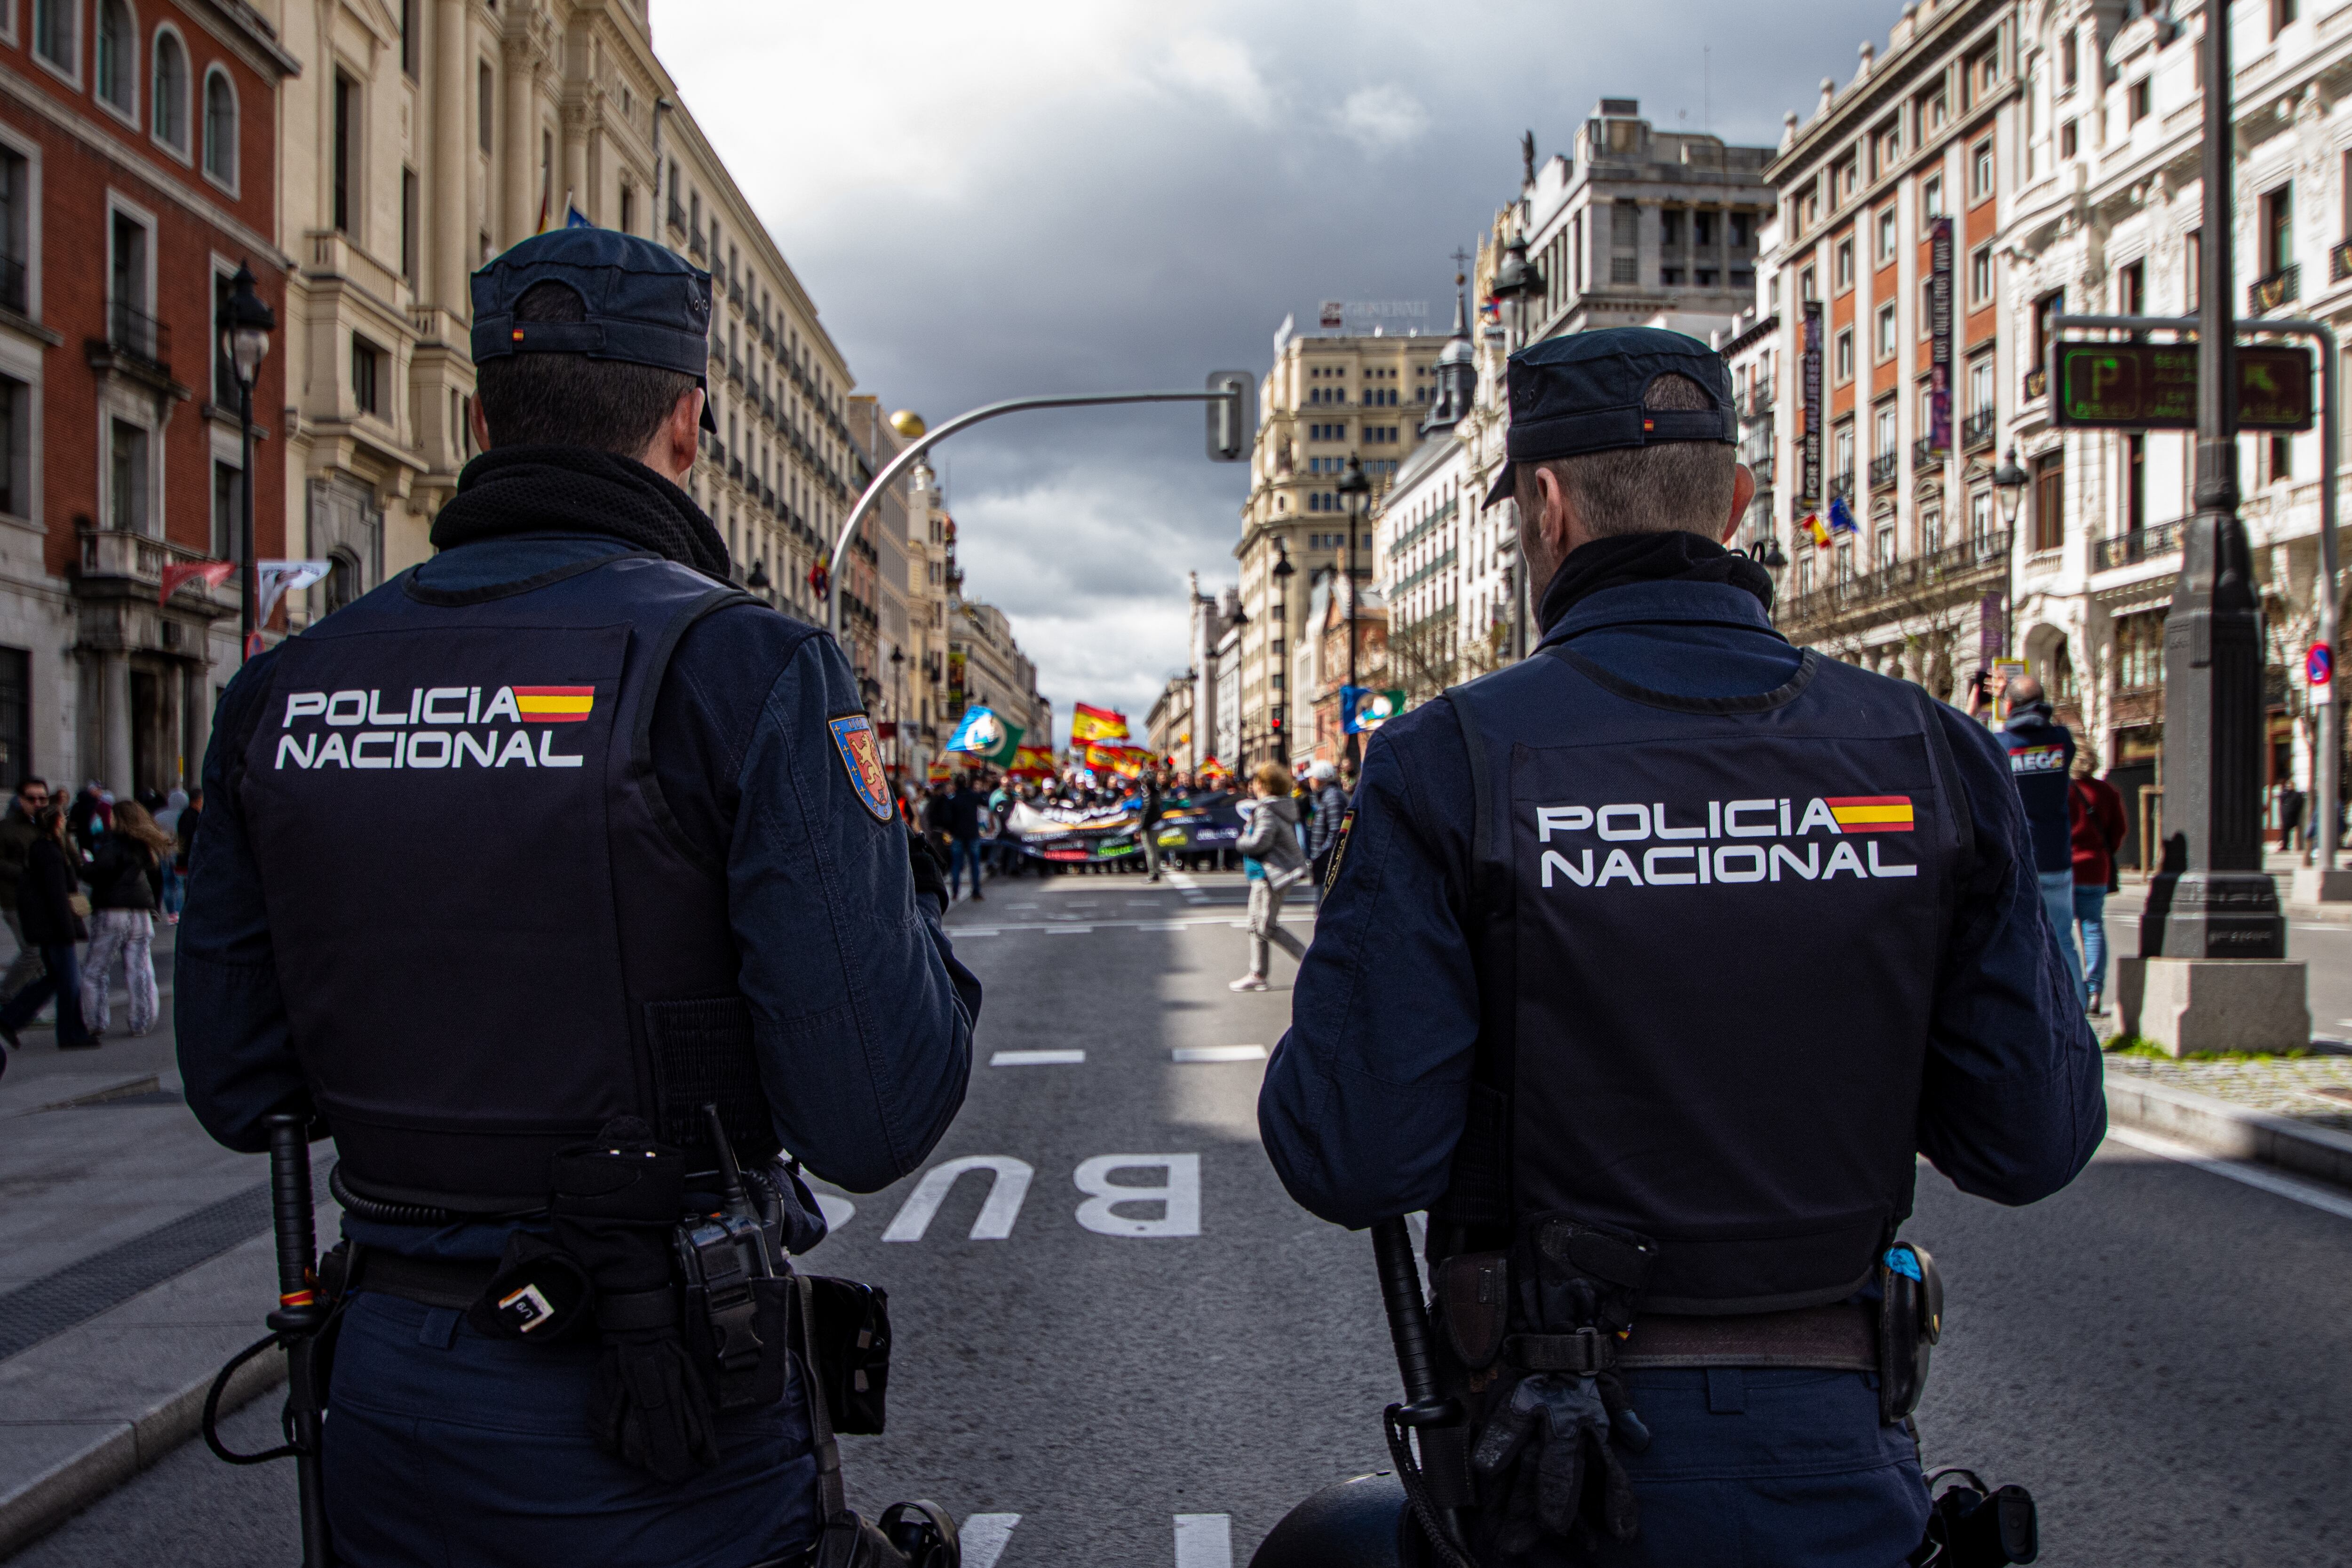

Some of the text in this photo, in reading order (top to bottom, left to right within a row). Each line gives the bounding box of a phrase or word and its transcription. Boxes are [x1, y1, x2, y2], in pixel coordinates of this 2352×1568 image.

[1805, 351, 1820, 499] POR SER MUJERES
[274, 730, 583, 769] NACIONAL
[1541, 840, 1918, 888] NACIONAL
